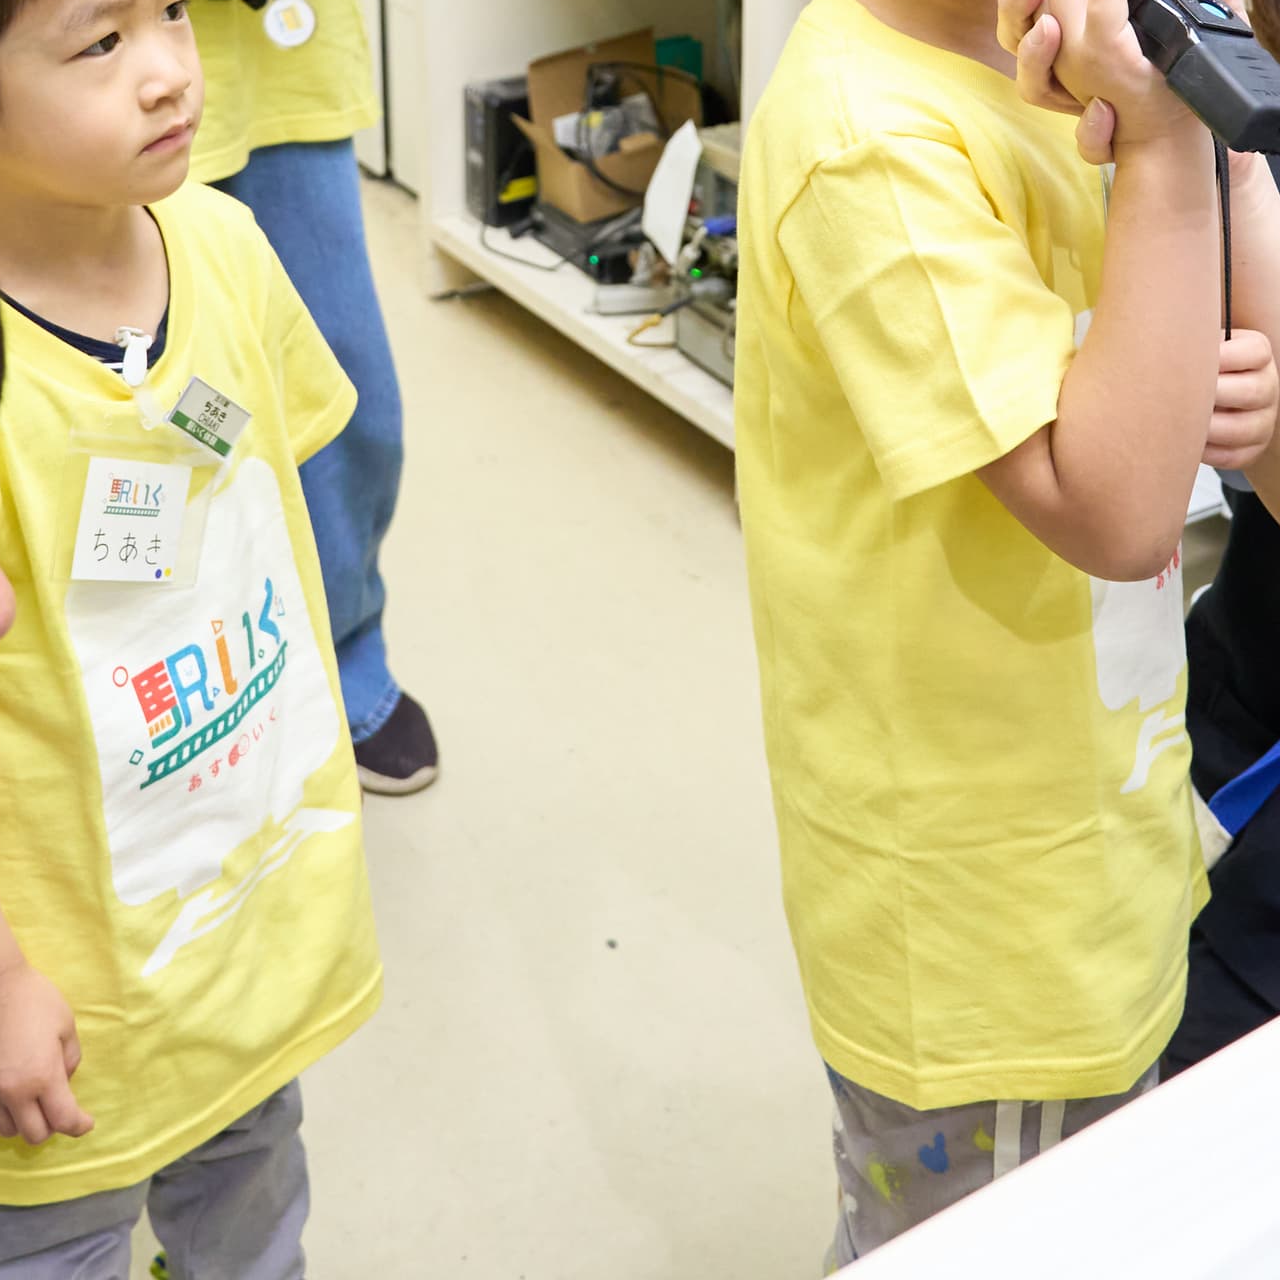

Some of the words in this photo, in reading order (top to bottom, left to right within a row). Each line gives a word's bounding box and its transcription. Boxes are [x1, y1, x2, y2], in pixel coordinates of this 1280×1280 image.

[198, 412, 221, 432] CHIAKI
[204, 401, 228, 423] ちあき
[93, 528, 162, 565] ちあき
